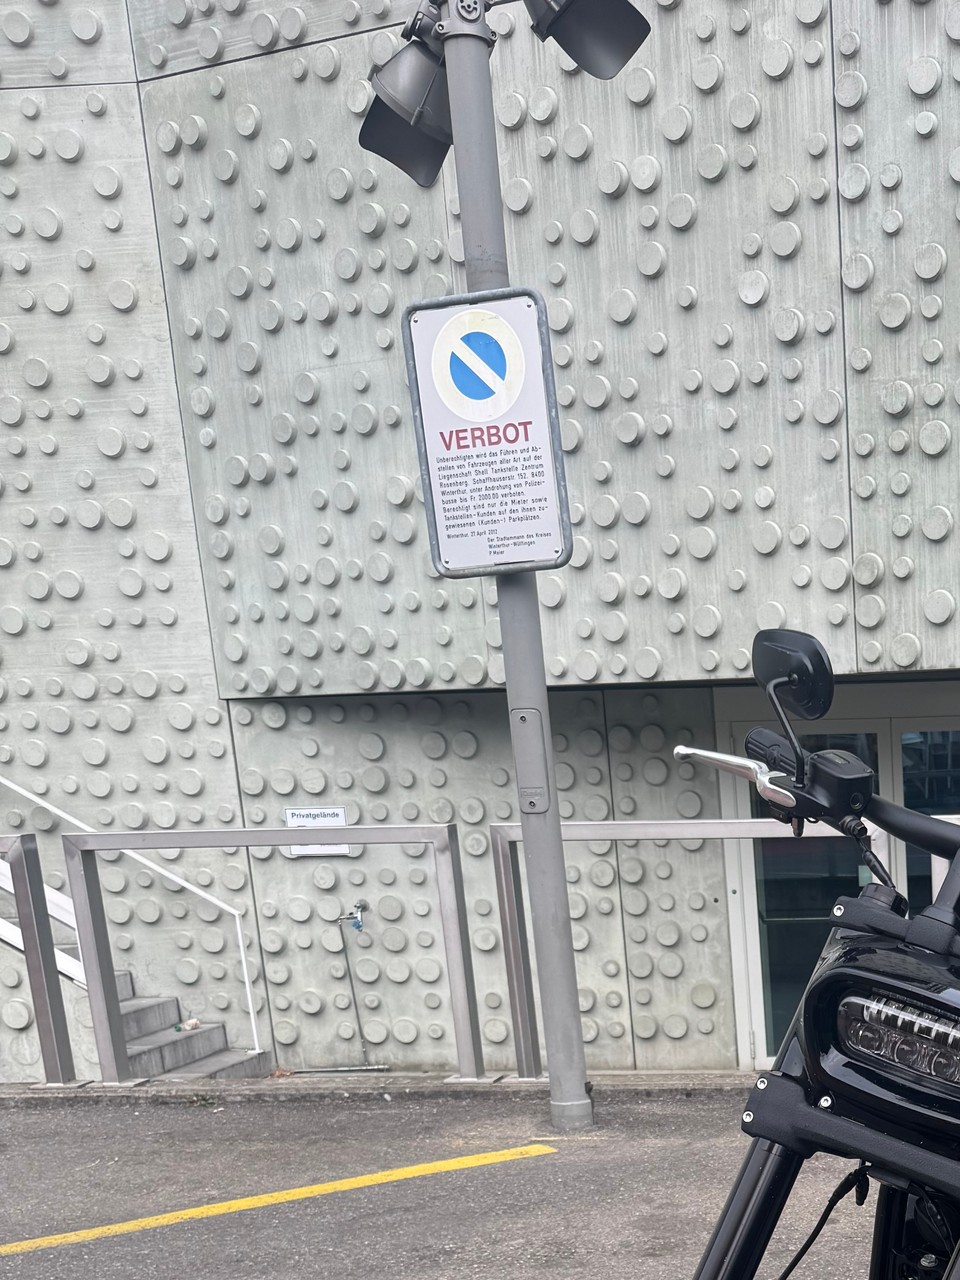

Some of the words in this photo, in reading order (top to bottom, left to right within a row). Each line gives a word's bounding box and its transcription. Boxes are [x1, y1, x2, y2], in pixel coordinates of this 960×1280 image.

[439, 420, 532, 451] VERBOT
[436, 455, 474, 463] Unberechtigten
[438, 471, 472, 481] Liegenschaft
[491, 466, 518, 474] Tankstelle
[521, 464, 544, 472] Zentrum
[443, 505, 470, 513] Berechtigt
[445, 522, 475, 531] gewiesenen
[478, 517, 506, 526] (Kunden-)
[291, 811, 339, 820] Privatgelände
